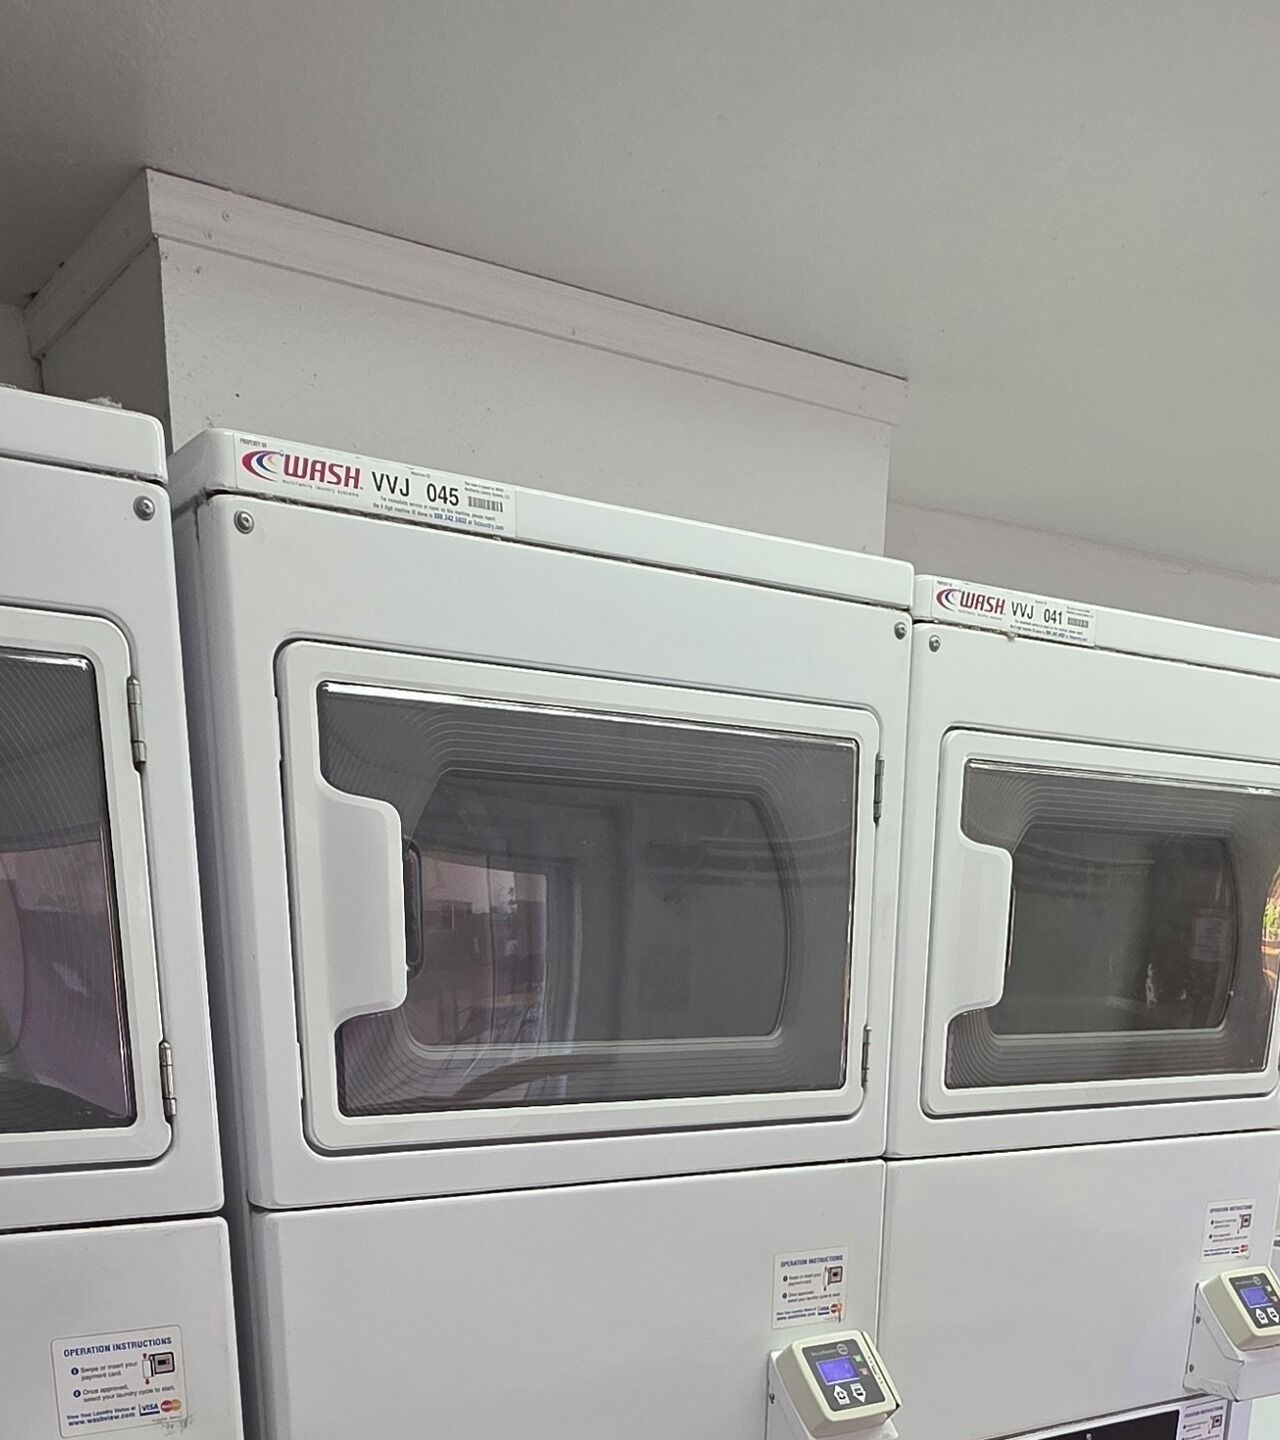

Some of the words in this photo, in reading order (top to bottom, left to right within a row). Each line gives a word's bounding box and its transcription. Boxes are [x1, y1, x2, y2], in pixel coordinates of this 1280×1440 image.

[283, 454, 360, 489] WASH
[372, 471, 409, 497] VVJ
[427, 483, 459, 506] 045
[960, 591, 1005, 614] WASH
[1012, 602, 1033, 619] VVJ
[1044, 609, 1062, 624] 041
[64, 1344, 110, 1357] OPERATION
[113, 1337, 172, 1351] INSTRUCTIONS
[81, 1366, 98, 1374] Swipe
[81, 1372, 106, 1381] payment
[139, 1388, 153, 1396] cycle
[142, 1403, 159, 1411] VISA
